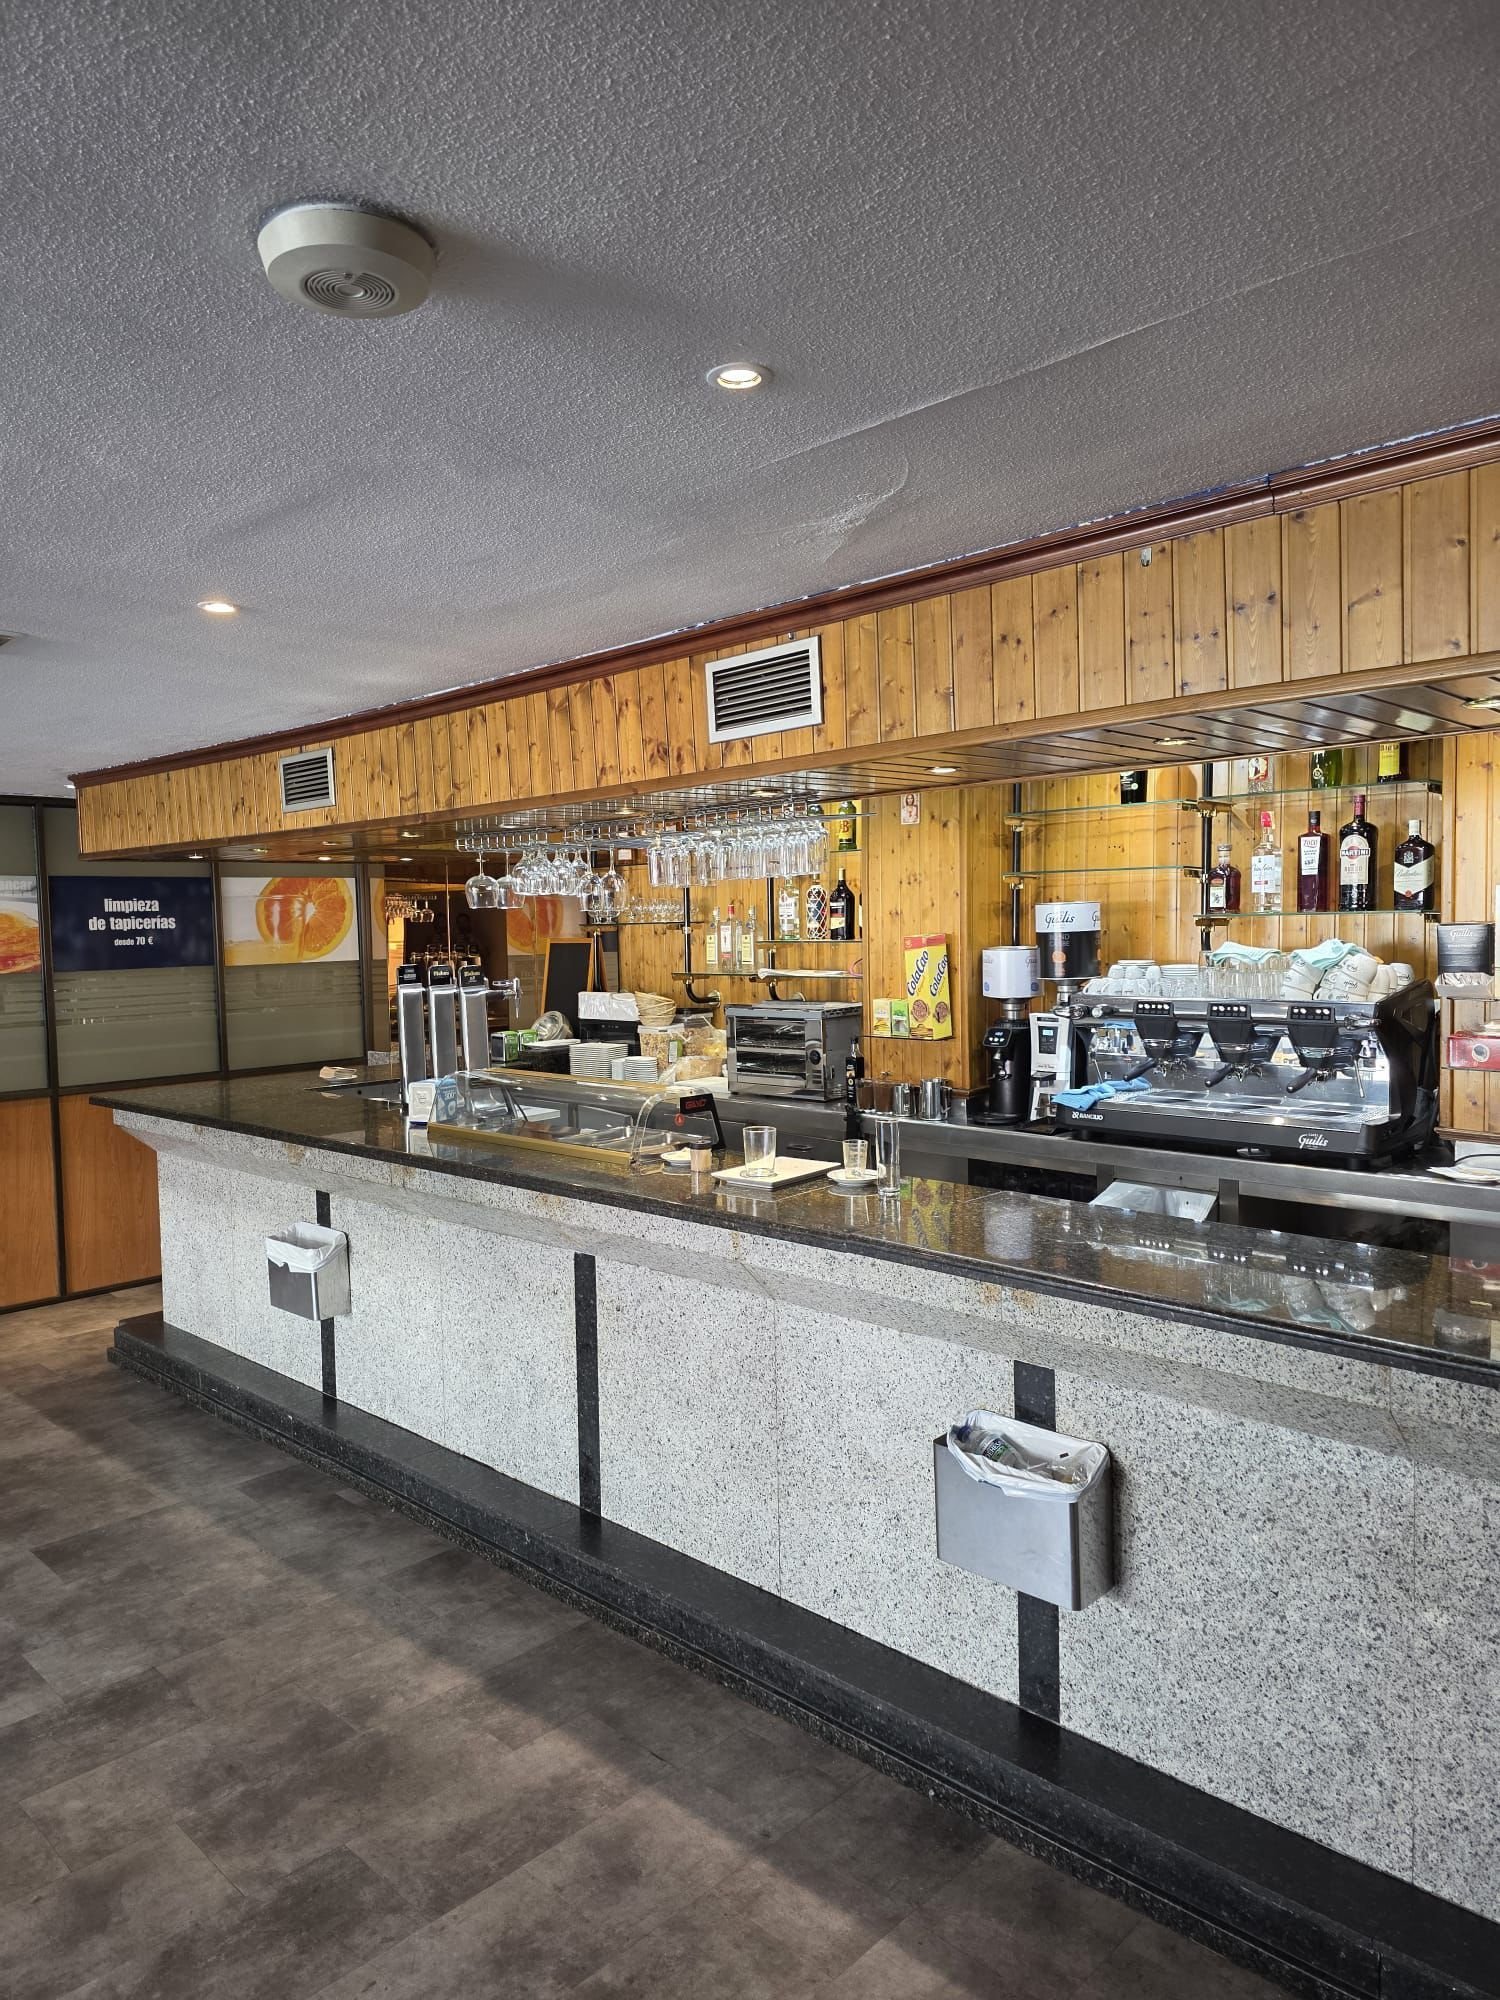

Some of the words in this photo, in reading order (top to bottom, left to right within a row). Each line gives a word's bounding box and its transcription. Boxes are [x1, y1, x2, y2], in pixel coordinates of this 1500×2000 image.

[1341, 849, 1370, 857] MARTINI
[104, 898, 160, 914] limpieza
[88, 916, 106, 931] de
[110, 915, 176, 932] tapicerías
[114, 938, 135, 946] desde
[136, 937, 145, 945] 70
[148, 936, 154, 945] €
[907, 950, 929, 996] ColaCao
[930, 954, 948, 997] ColaCao
[1298, 1134, 1329, 1149] Guilis
